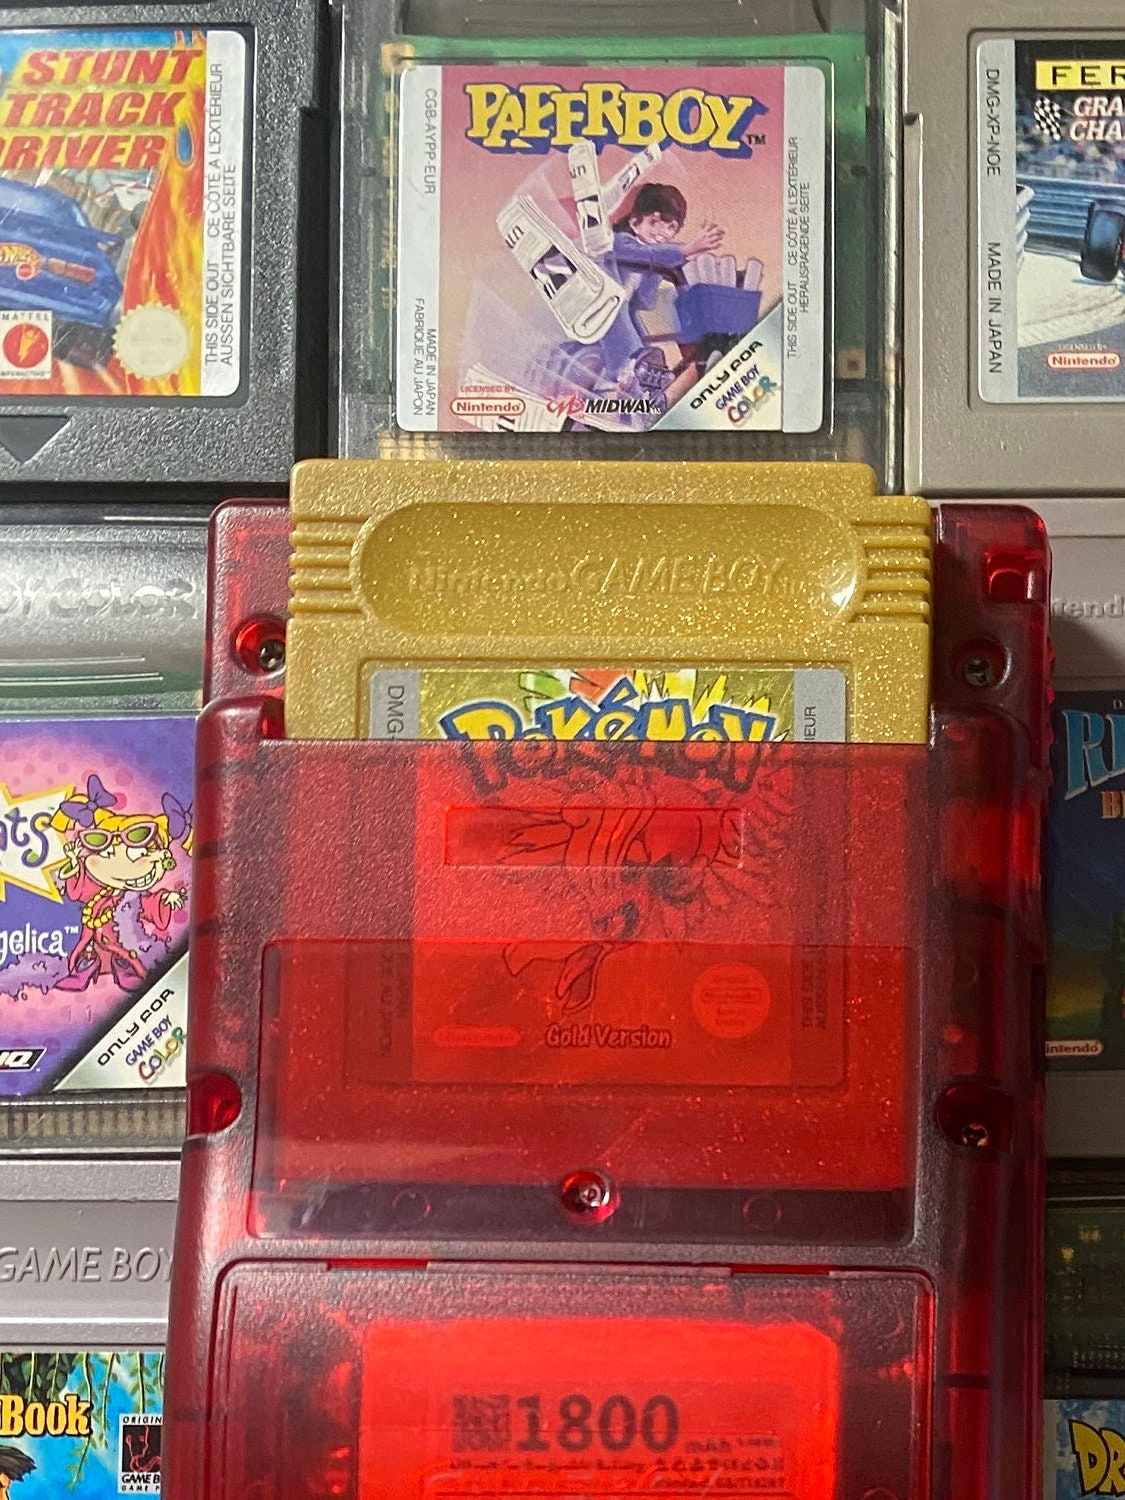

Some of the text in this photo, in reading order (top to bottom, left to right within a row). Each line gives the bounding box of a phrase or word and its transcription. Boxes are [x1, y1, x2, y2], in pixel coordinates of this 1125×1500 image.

[23, 49, 203, 84] STUNT
[5, 91, 176, 128] TRACK
[464, 82, 762, 157] PAPERBOY
[985, 68, 1003, 374] DMG-XP-NOE MADE IN JAPAN
[220, 165, 236, 366] AUSSEN SICHTBARE SEITE
[204, 260, 220, 366] THIS SIDE OUT
[425, 328, 437, 416] MADE IN JAPAN
[1052, 355, 1116, 367] Nintendo
[413, 377, 424, 416] JAPON
[455, 400, 522, 414] Nintendo
[584, 399, 655, 415] MIDWAY
[97, 1021, 141, 1066] ONLY
[546, 1022, 591, 1049] Gold
[596, 1024, 673, 1049] Version
[0, 1402, 91, 1436] Book
[516, 1394, 680, 1451] 1800
